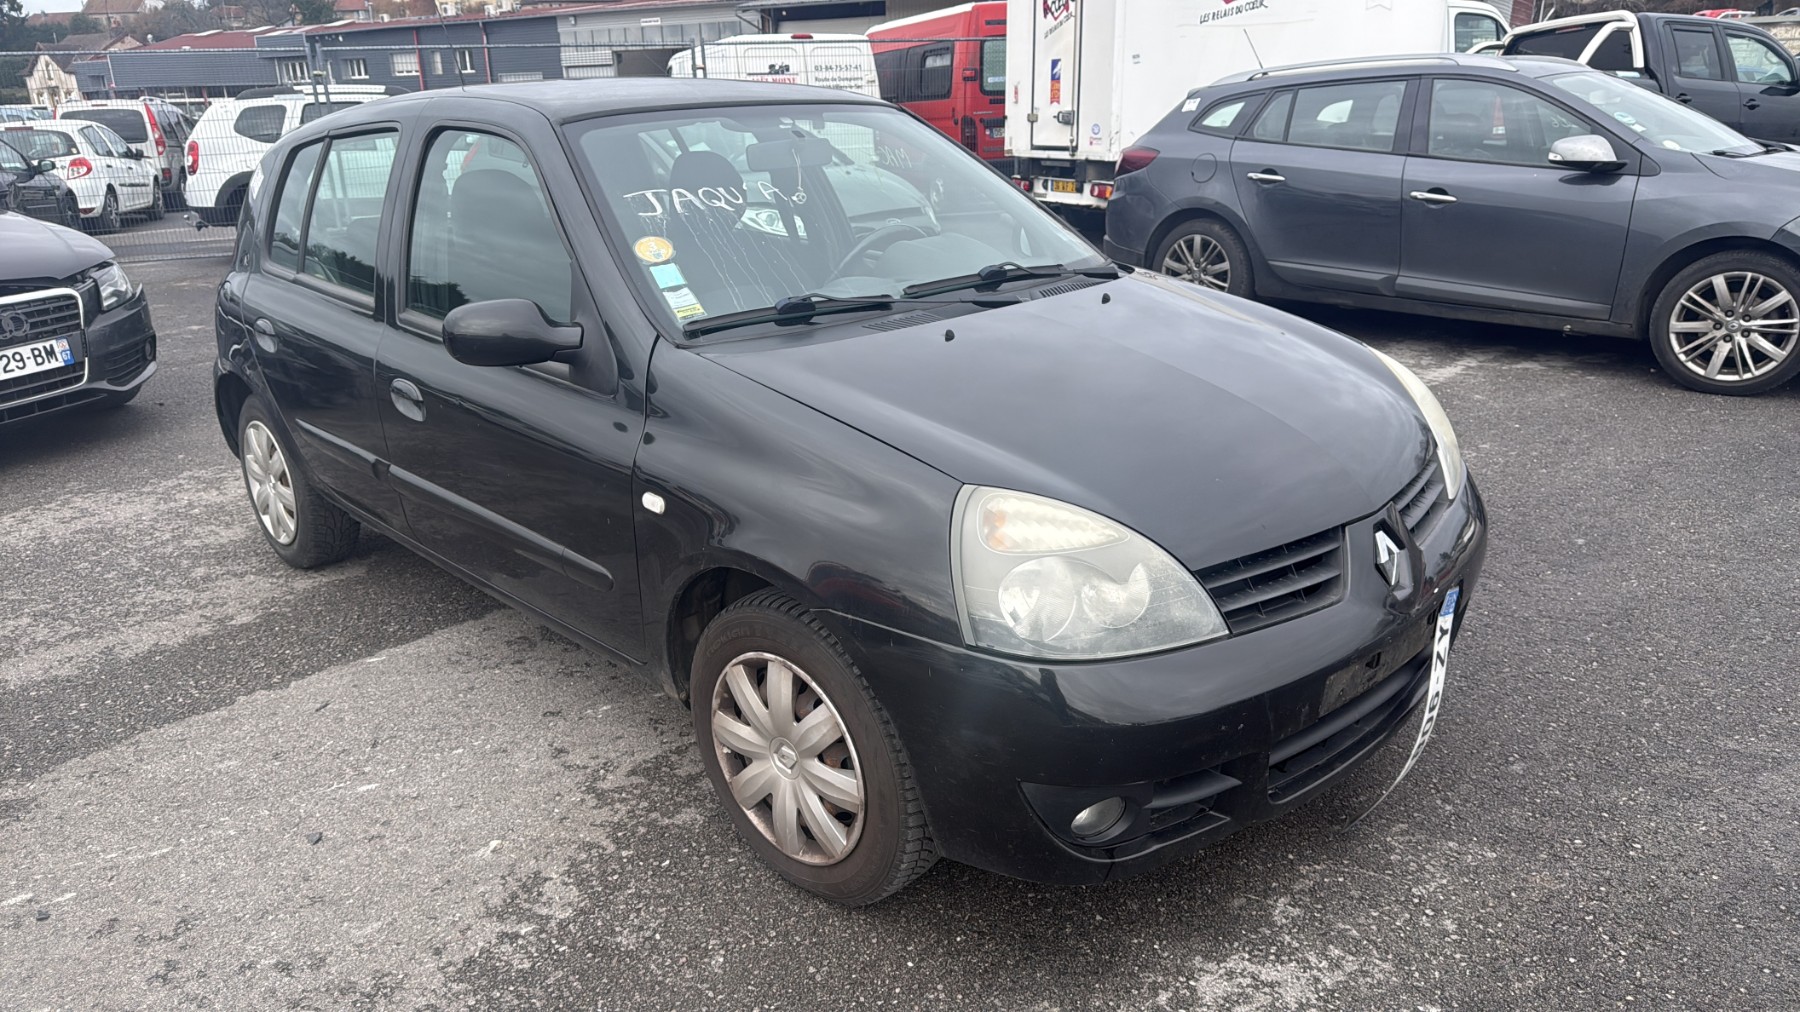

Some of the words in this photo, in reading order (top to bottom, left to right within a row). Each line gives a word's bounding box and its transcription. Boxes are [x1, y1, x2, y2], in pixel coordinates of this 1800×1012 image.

[1199, 12, 1211, 24] LES
[1211, 7, 1235, 21] RELAIS
[0, 343, 59, 374] 29-BM
[61, 350, 71, 361] 67
